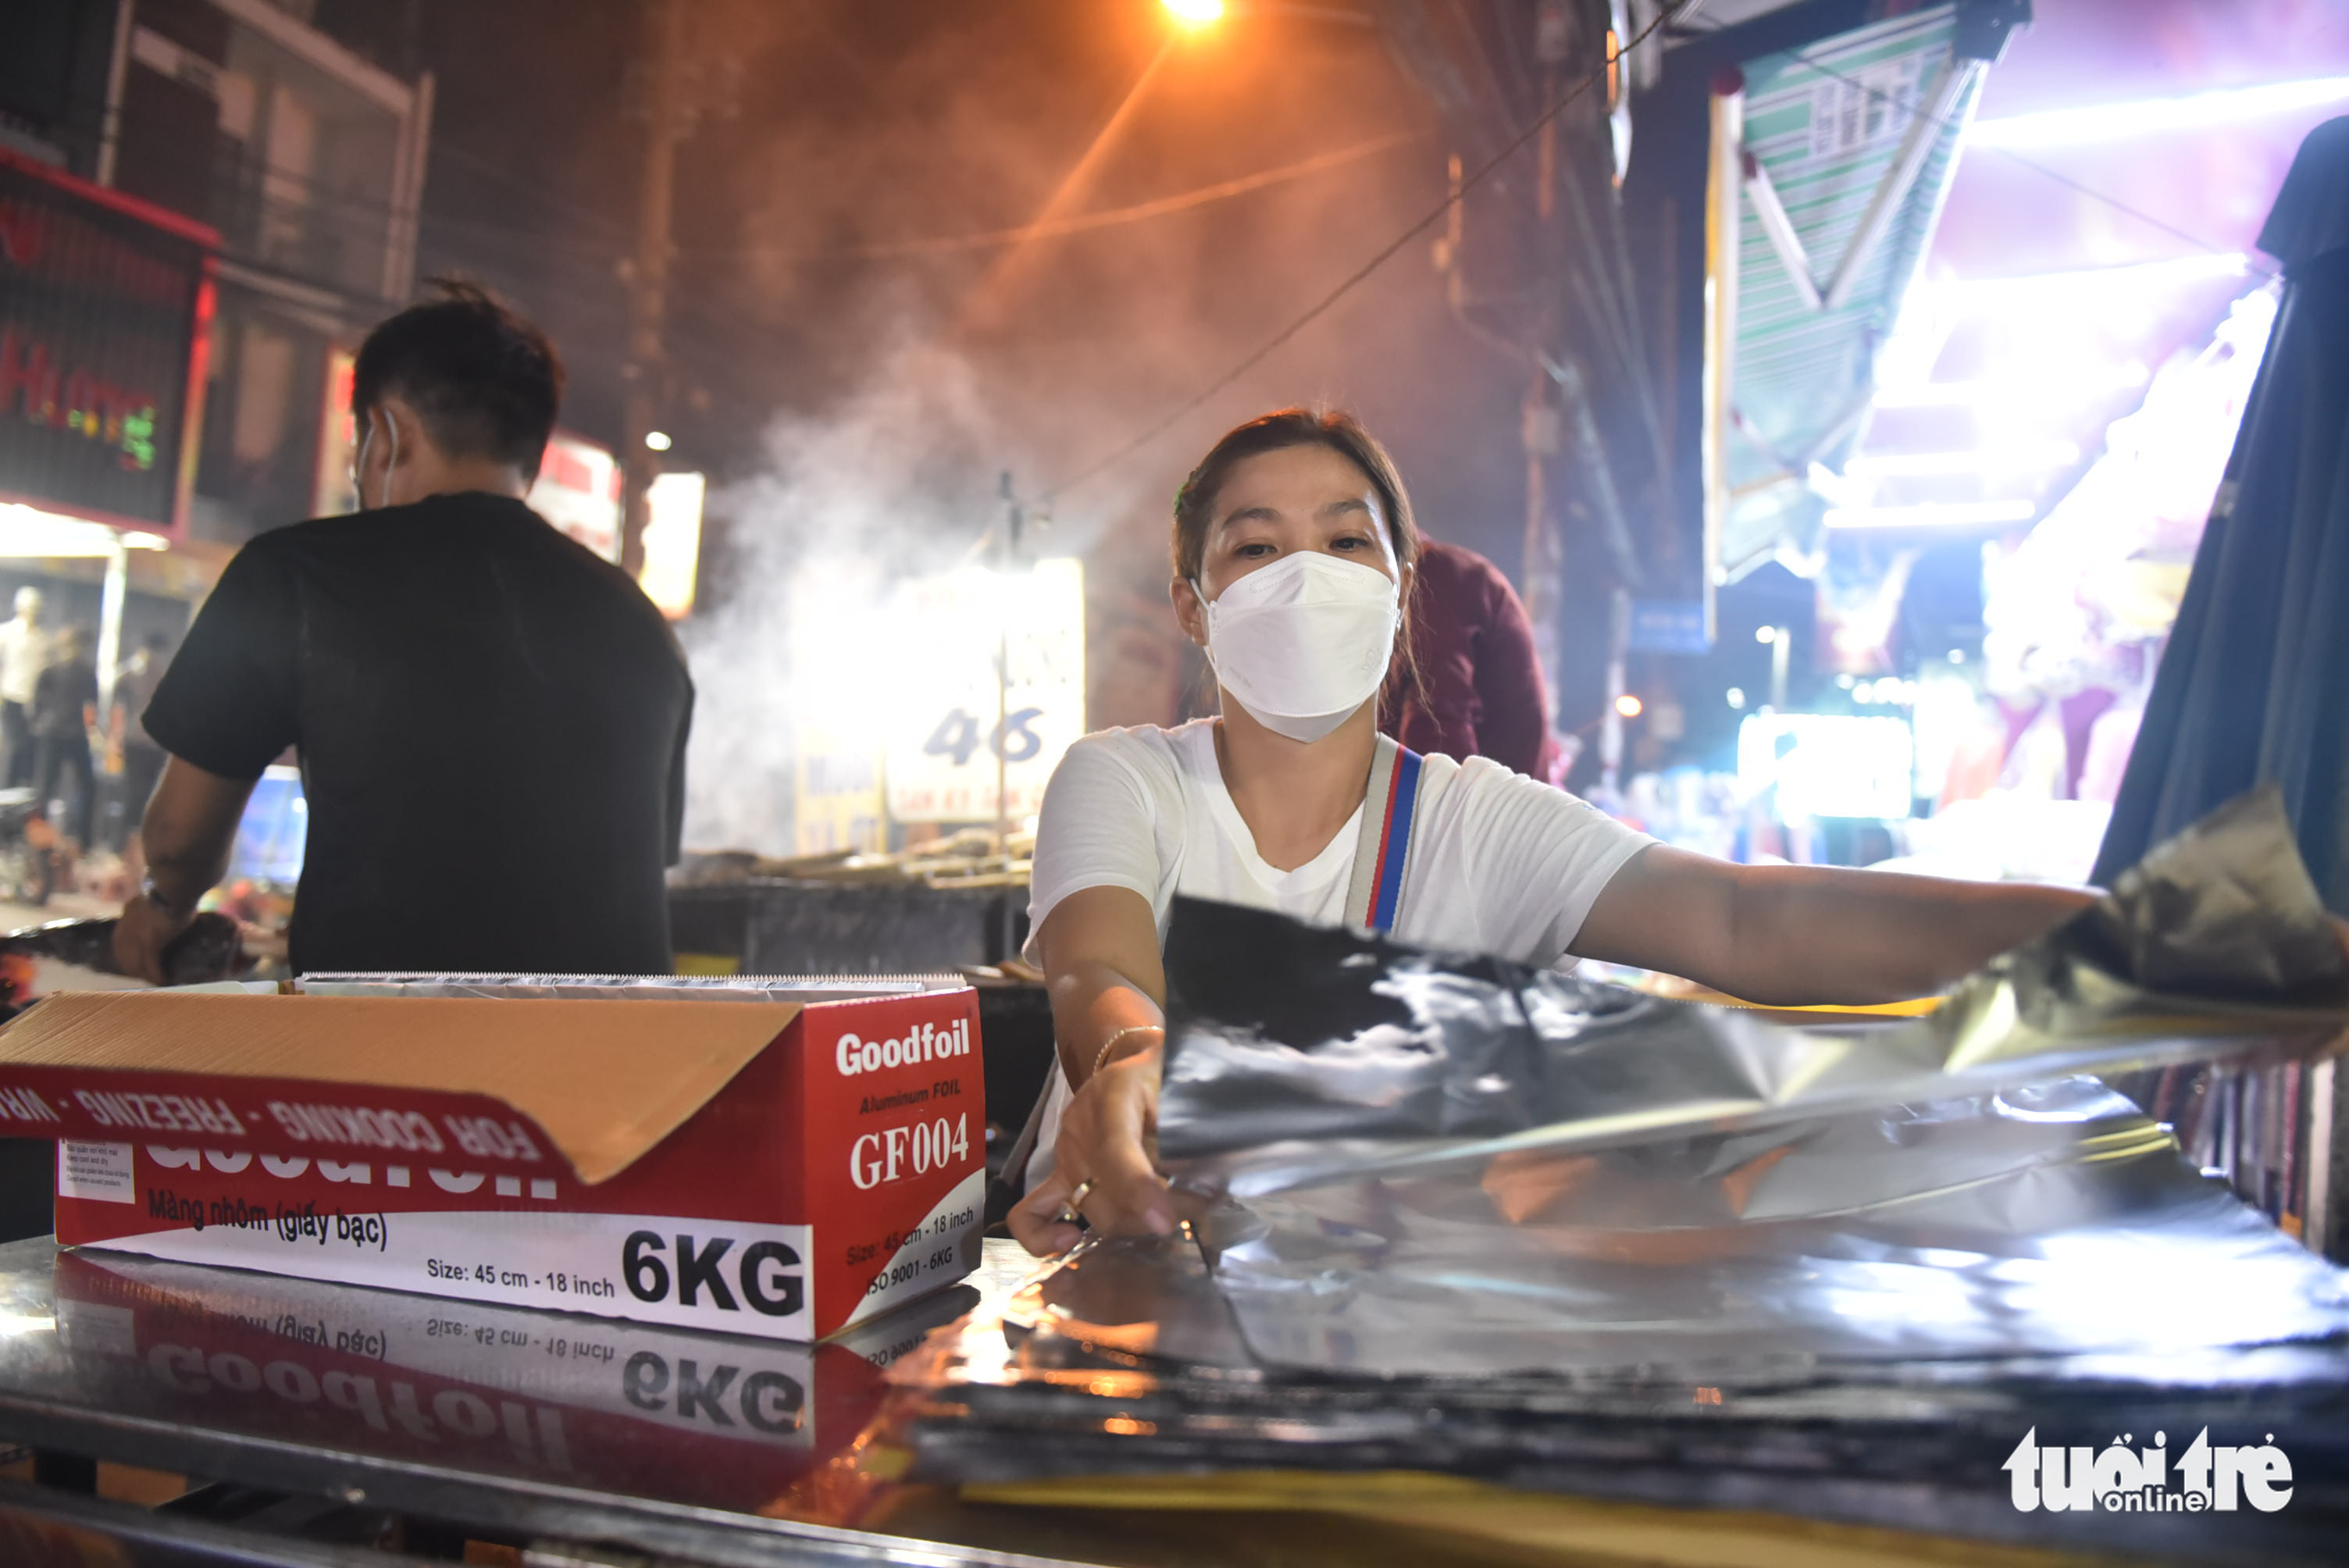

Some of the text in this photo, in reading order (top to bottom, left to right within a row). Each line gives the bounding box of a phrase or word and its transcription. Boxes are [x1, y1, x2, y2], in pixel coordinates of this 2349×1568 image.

[836, 1017, 970, 1077] Goodfoil
[73, 1089, 247, 1136] FREEZING
[860, 1078, 962, 1115] Aluminum FOIL
[266, 1100, 446, 1153] COOKING
[442, 1113, 544, 1161] FOR
[850, 1112, 969, 1189] GF004
[148, 1188, 387, 1253] Màng nhôm (giấy bạc)
[903, 1228, 922, 1246] cm
[933, 1215, 946, 1235] 18
[950, 1206, 974, 1231] inch
[427, 1258, 469, 1281] Size:
[474, 1263, 496, 1285] 45
[501, 1270, 529, 1288] cm
[546, 1271, 568, 1292] 18
[572, 1274, 615, 1298] inch
[622, 1230, 804, 1317] 6KG
[866, 1271, 889, 1295] ISO
[891, 1260, 920, 1286] 9001
[929, 1246, 953, 1270] 6KG
